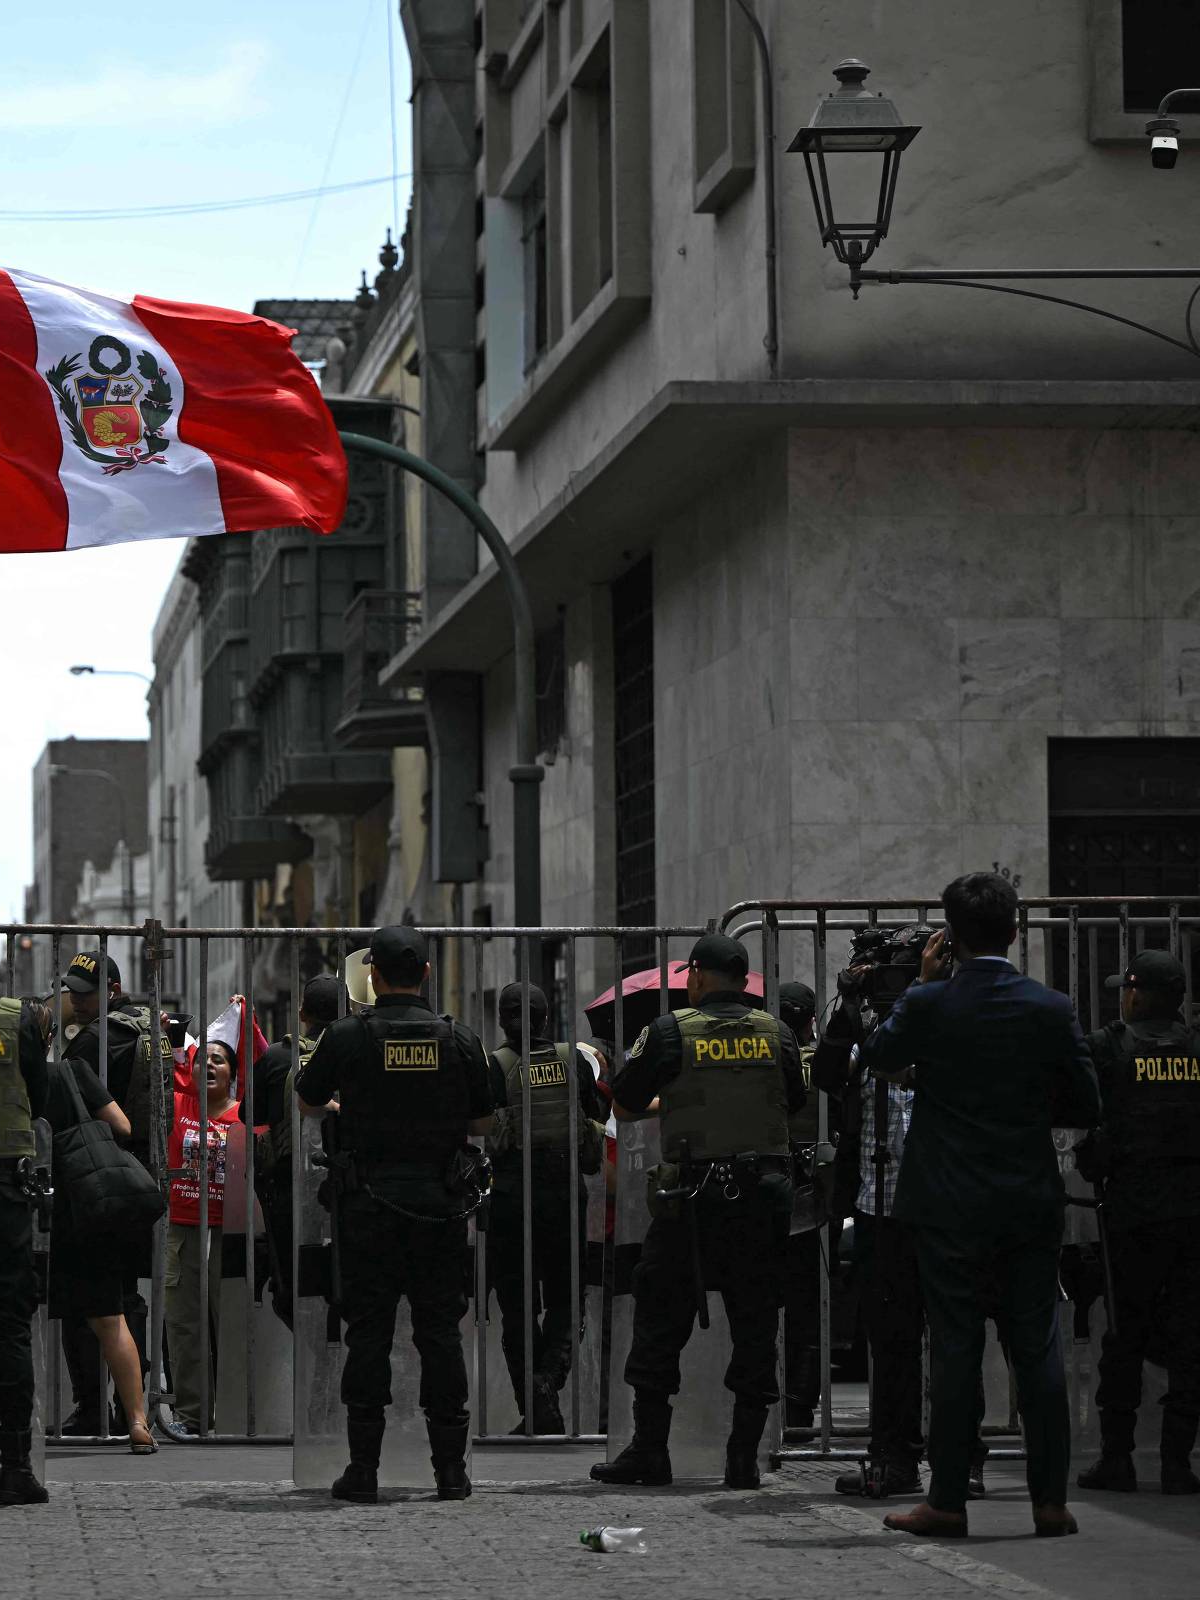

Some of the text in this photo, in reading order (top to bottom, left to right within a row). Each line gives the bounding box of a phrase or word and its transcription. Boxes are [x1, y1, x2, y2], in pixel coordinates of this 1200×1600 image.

[387, 1045, 436, 1066] POLICIA
[695, 1037, 772, 1061] POLICIA
[529, 1063, 564, 1085] OLICIA
[1135, 1057, 1200, 1081] POLICIA
